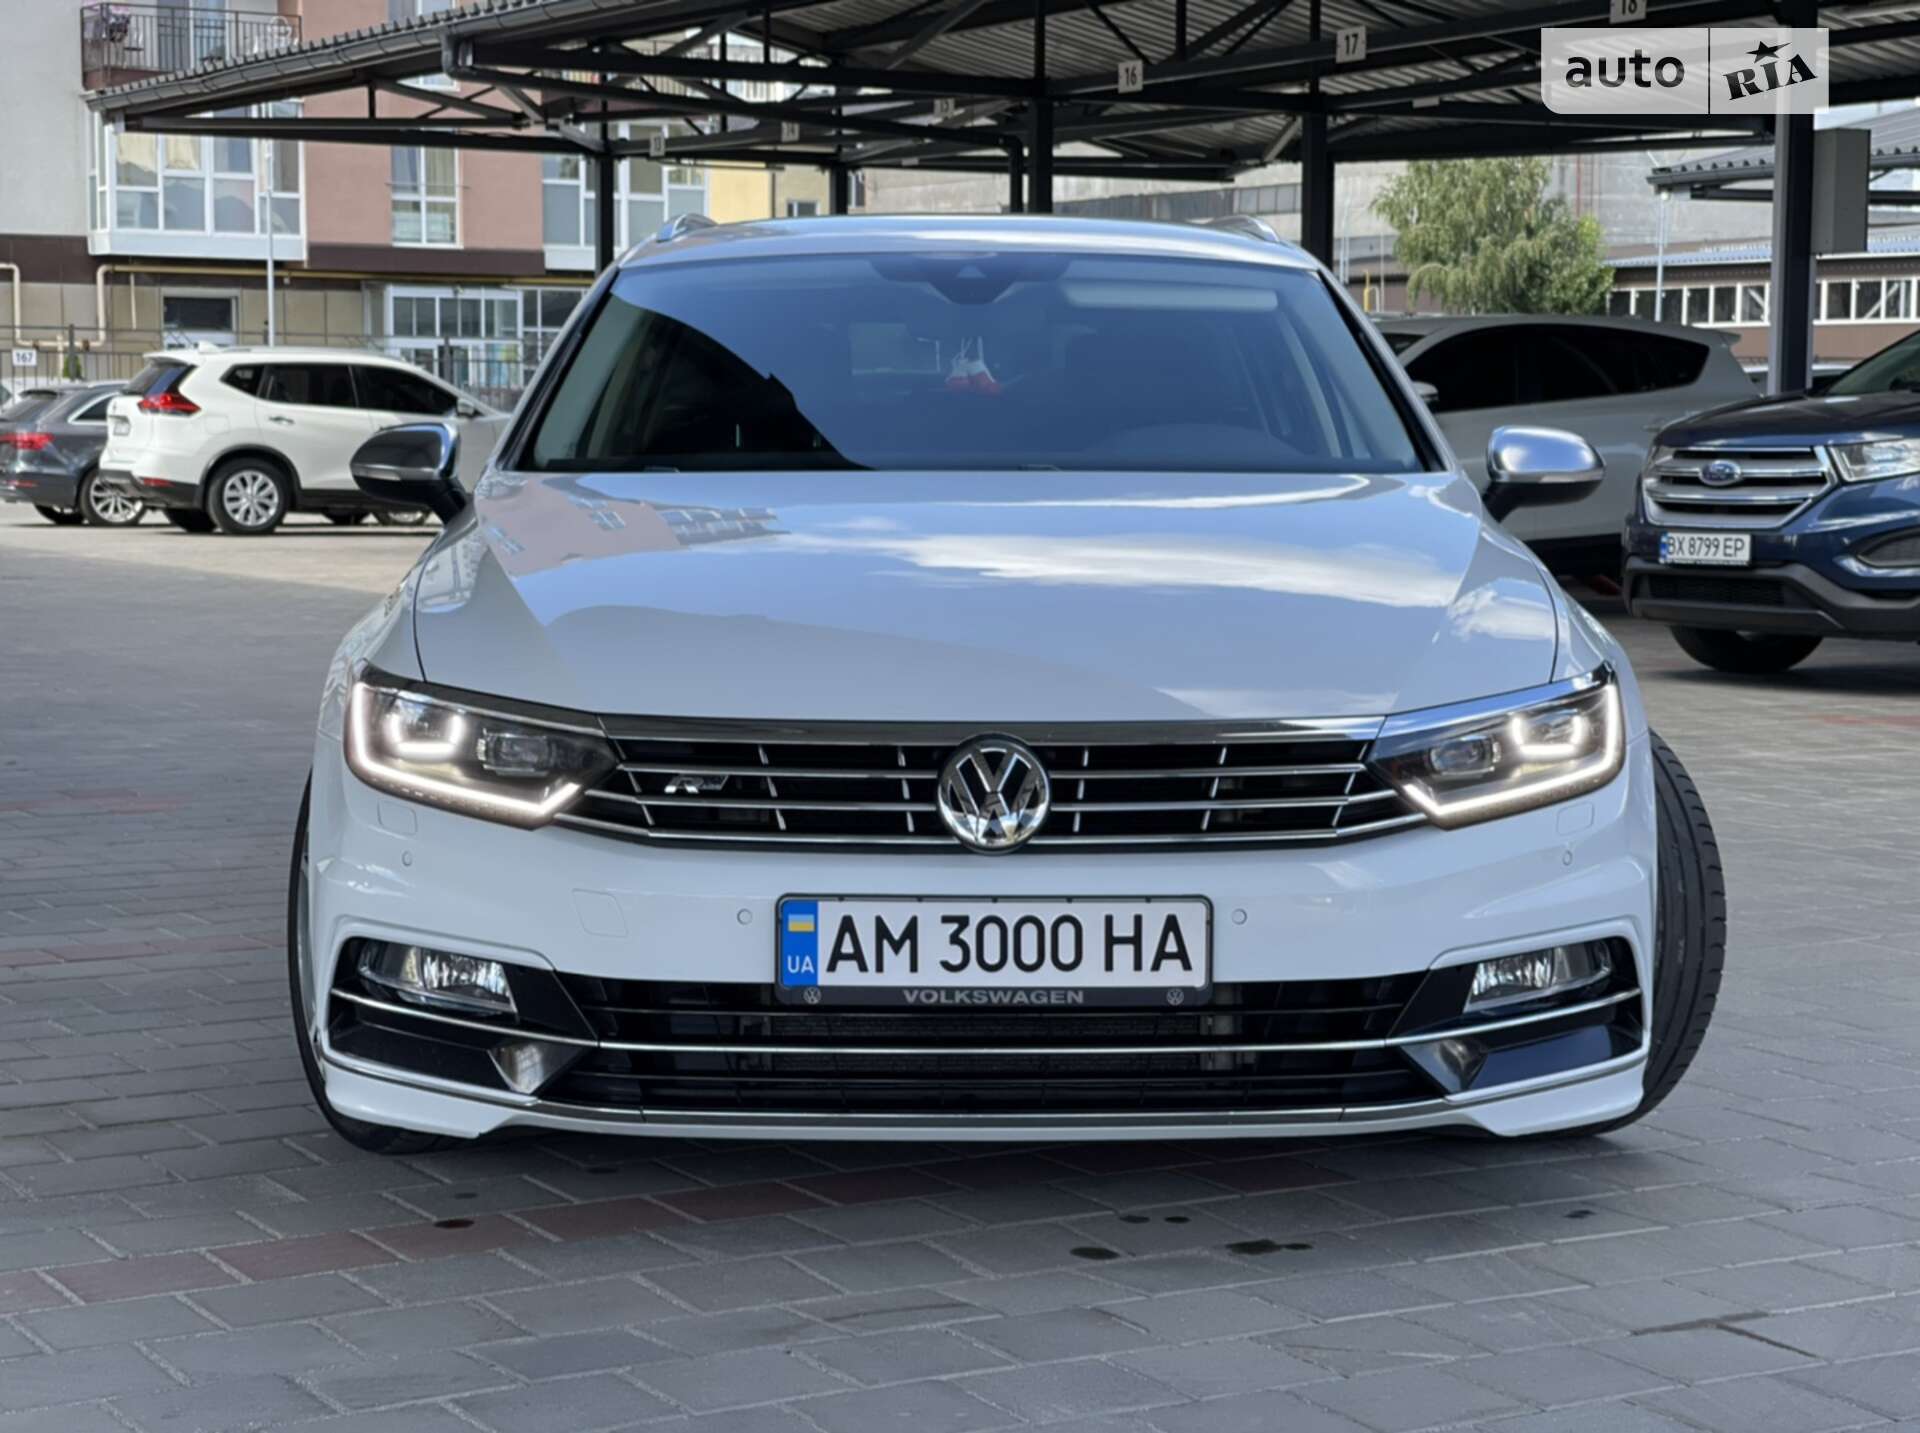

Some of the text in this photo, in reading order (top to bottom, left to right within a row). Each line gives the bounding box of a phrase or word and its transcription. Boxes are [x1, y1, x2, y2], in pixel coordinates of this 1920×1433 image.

[1344, 33, 1359, 55] 17
[1125, 65, 1137, 86] 16
[15, 351, 33, 363] 167
[1688, 536, 1720, 557] 8799
[1723, 537, 1745, 557] EP
[826, 913, 1193, 973] AM 3000 HA
[786, 954, 815, 974] UA
[902, 989, 1084, 1004] VOLKSWAGEN
